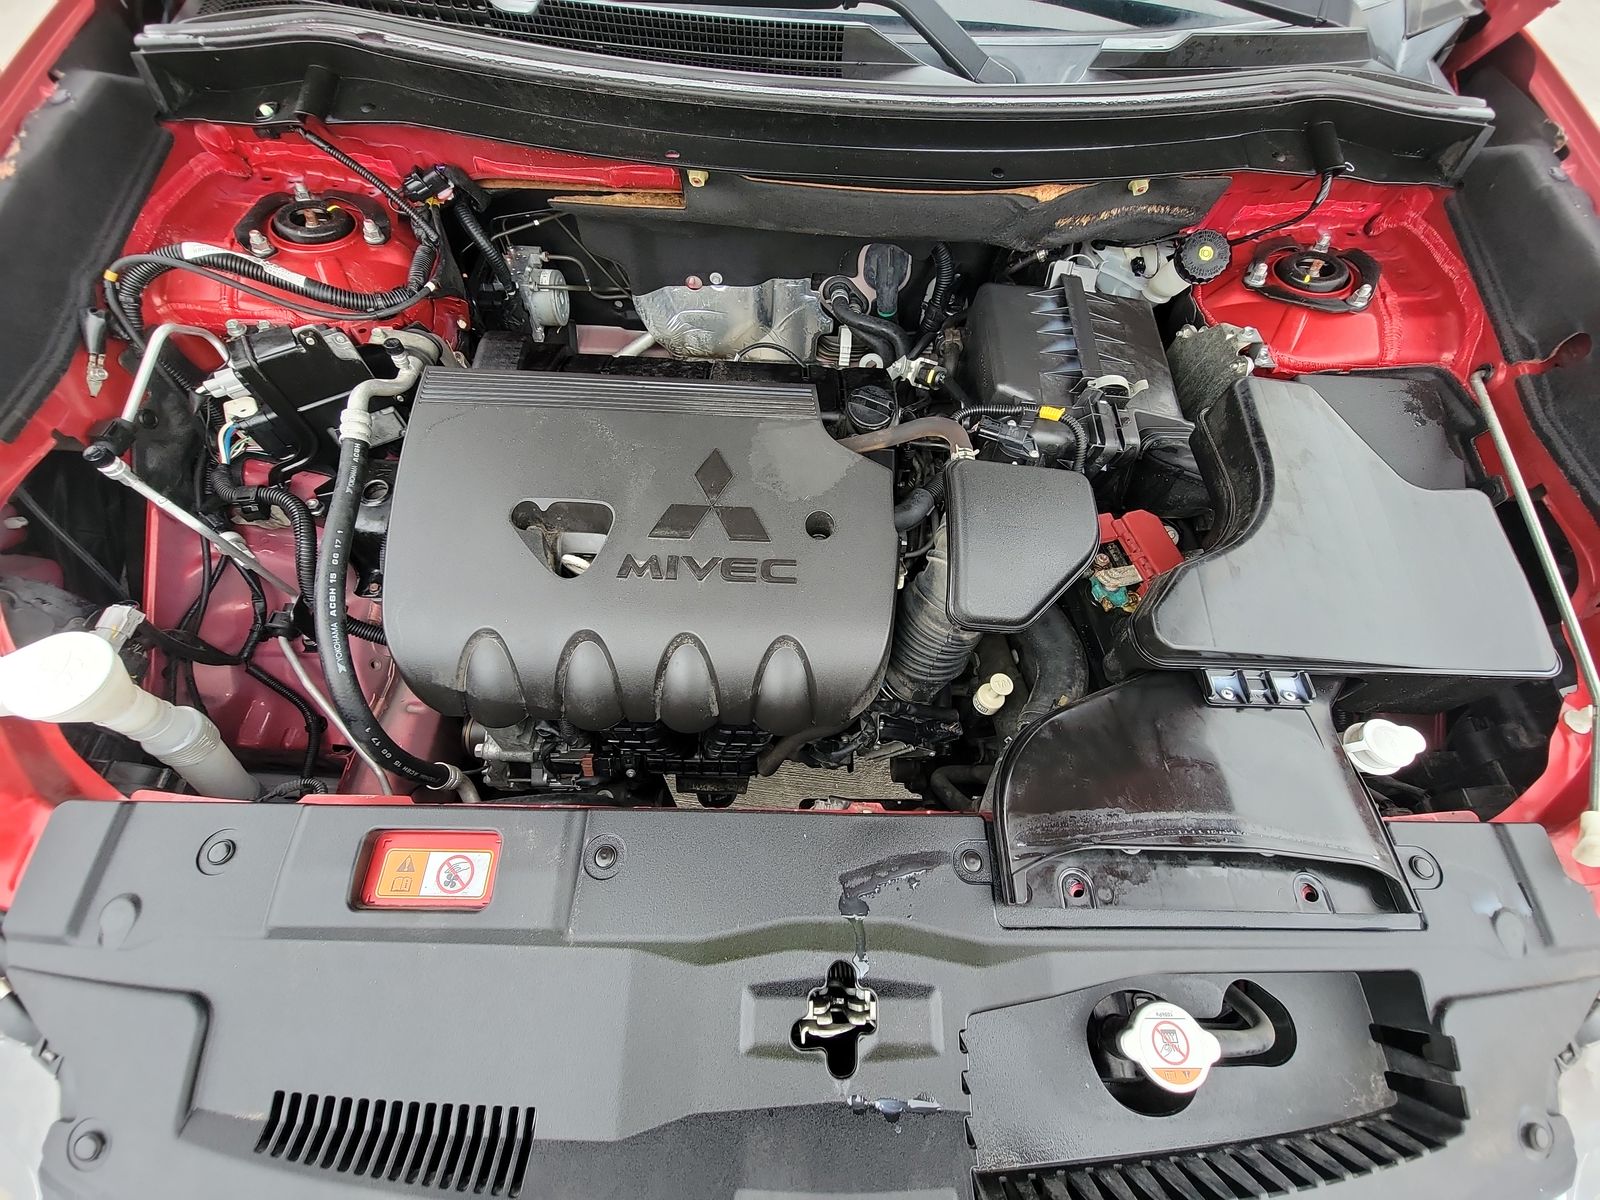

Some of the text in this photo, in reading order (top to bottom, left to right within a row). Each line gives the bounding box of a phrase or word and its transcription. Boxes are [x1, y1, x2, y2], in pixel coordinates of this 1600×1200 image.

[334, 539, 342, 548] 17
[616, 553, 797, 584] MIVEC
[330, 622, 343, 662] YOKOHAMA
[371, 737, 381, 747] 17
